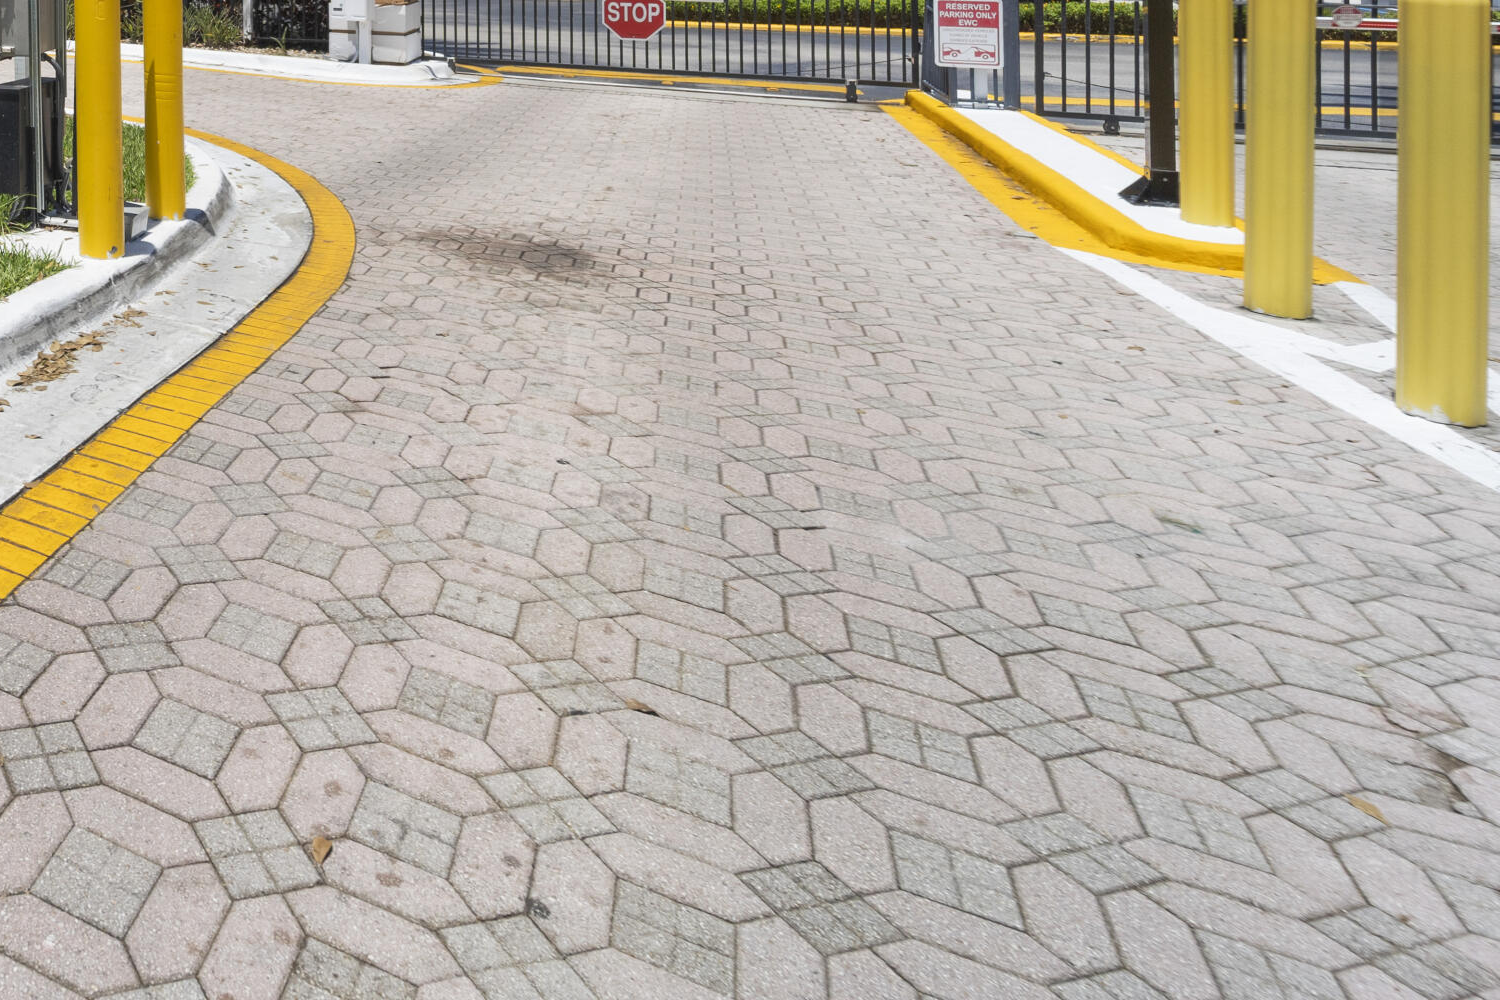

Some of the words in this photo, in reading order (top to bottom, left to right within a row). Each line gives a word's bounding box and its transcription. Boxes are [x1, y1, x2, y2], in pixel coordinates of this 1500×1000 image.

[945, 3, 991, 11] RESERVED
[607, 1, 660, 23] STOP
[939, 10, 974, 18] PARKING
[975, 11, 997, 19] ONLY
